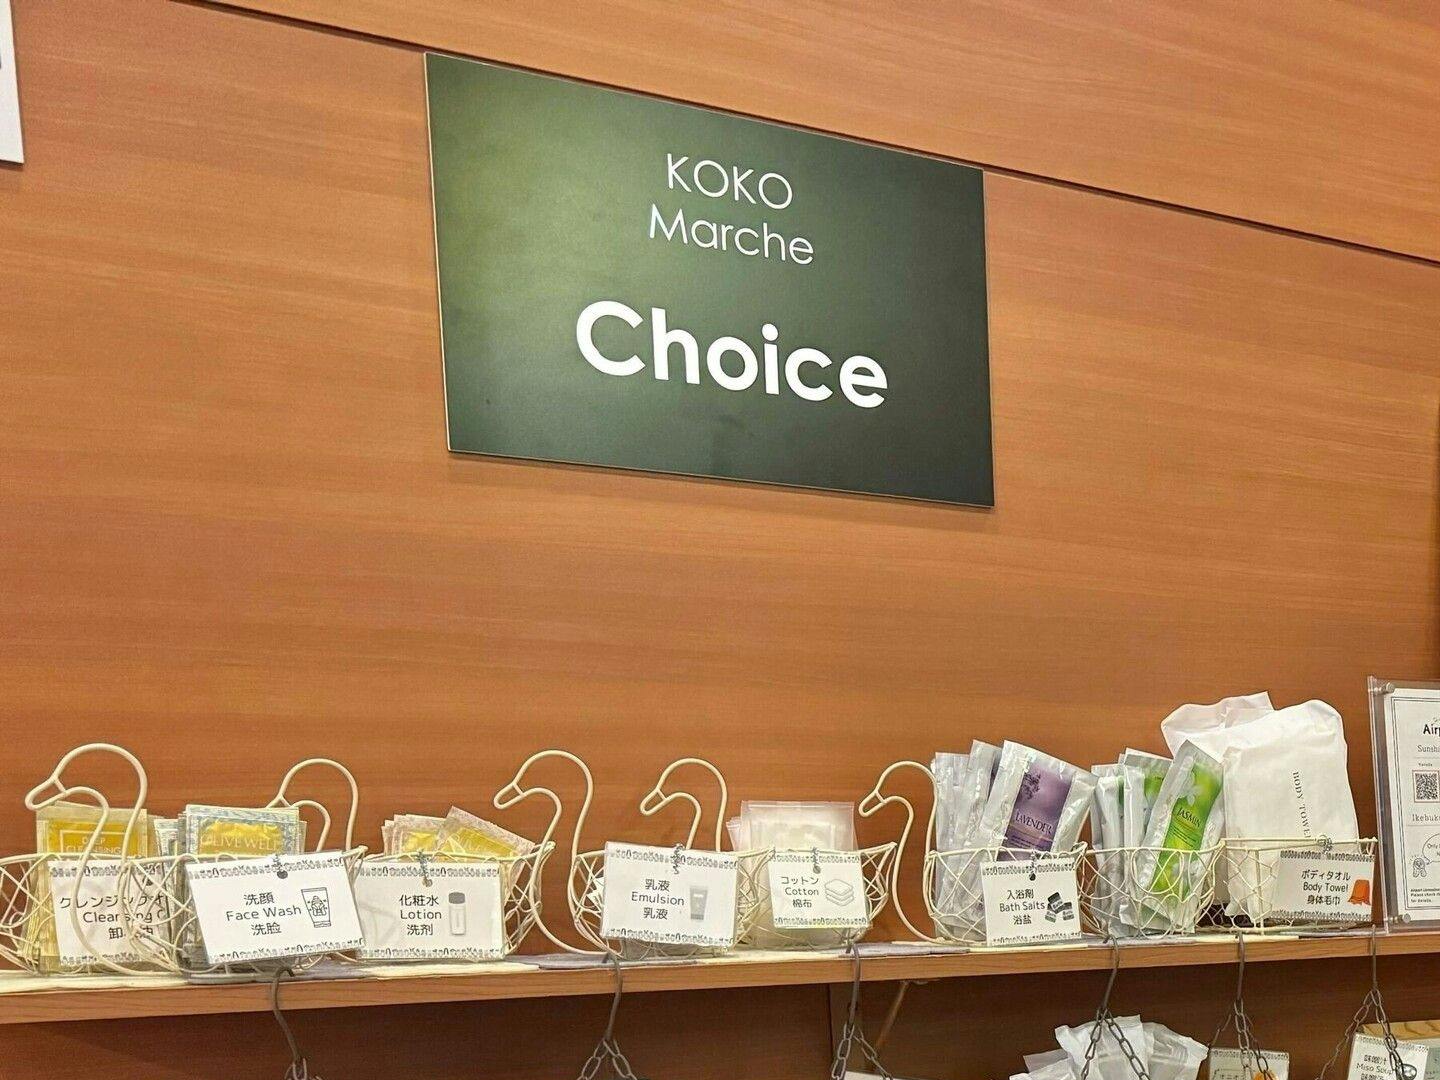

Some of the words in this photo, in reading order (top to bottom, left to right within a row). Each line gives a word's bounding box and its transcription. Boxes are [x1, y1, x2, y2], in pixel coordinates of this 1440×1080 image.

[667, 153, 793, 209] KOKO
[649, 204, 814, 265] Marche
[576, 300, 887, 408] Choice
[1292, 771, 1303, 800] BODY
[644, 878, 670, 891] 乳液
[780, 876, 820, 885] コットン
[784, 886, 820, 897] Cotton
[1302, 882, 1322, 894] Body
[1325, 882, 1349, 893] Towel
[243, 892, 274, 905] 洗顔
[398, 894, 440, 908] 化粧水
[631, 891, 684, 906] Emulsion
[1306, 893, 1341, 905] 身体毛巾
[643, 906, 668, 920] 乳液
[1000, 903, 1020, 912] Bath
[1022, 901, 1045, 911] Salts
[226, 909, 258, 922] Face
[264, 905, 301, 919] Wash
[399, 909, 442, 921] Lotion
[251, 922, 281, 936] 洗脸
[1356, 1062, 1377, 1072] Miso
